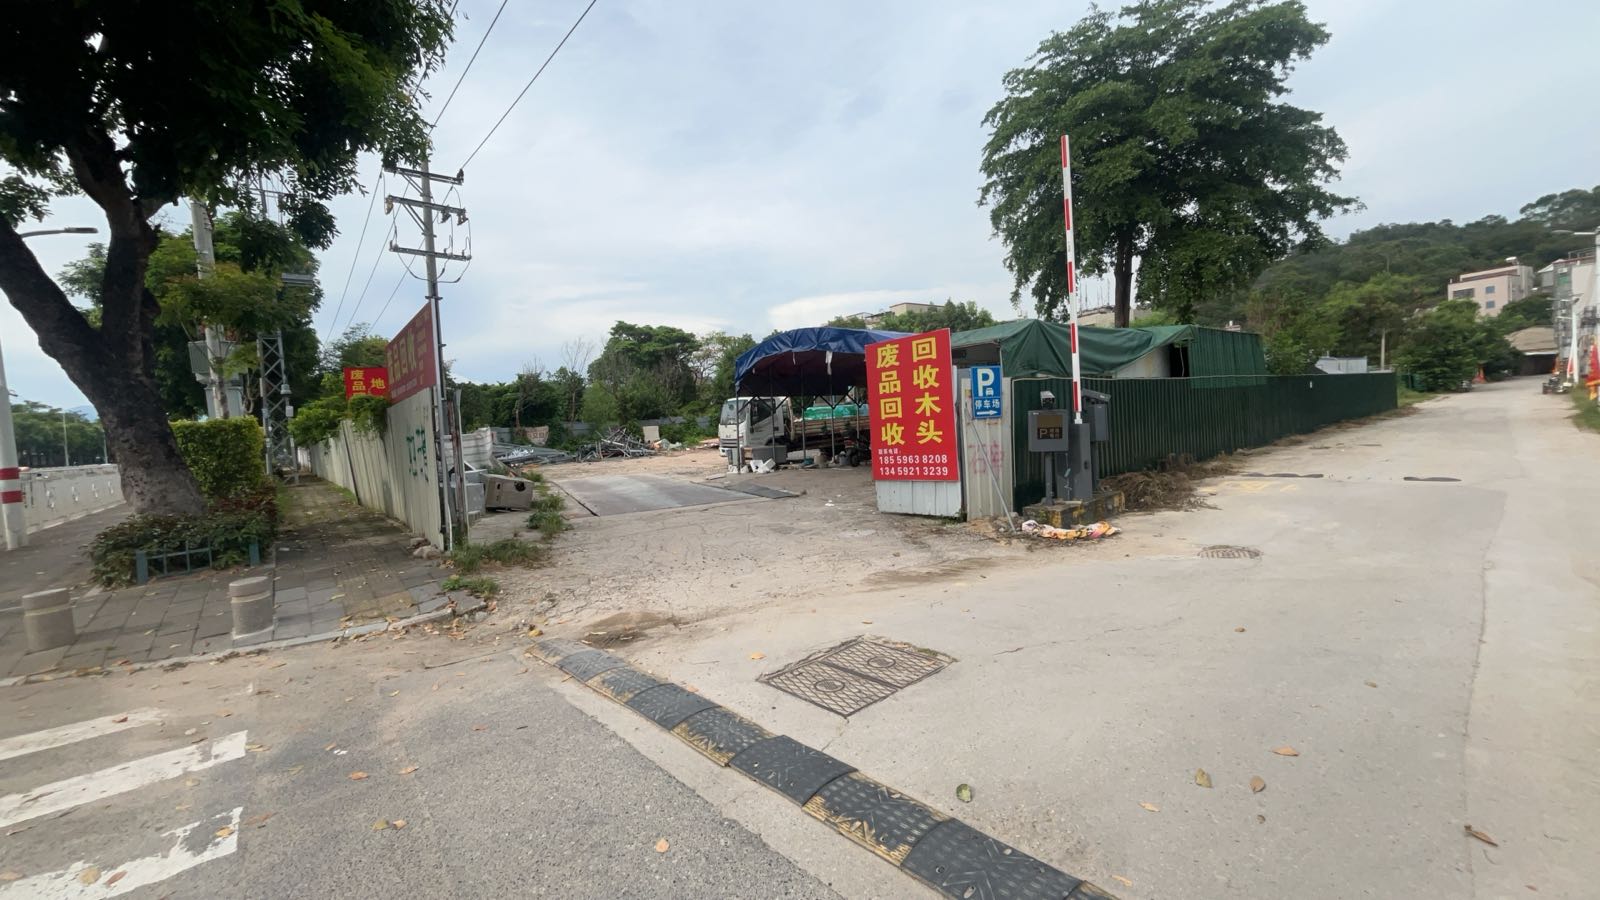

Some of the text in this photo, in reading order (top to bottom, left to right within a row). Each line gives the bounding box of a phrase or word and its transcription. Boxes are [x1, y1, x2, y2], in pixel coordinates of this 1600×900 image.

[350, 369, 367, 396] 废品
[370, 377, 386, 389] 地
[912, 337, 943, 445] 回收木头
[976, 368, 995, 397] P
[877, 343, 906, 446] 废品回收
[975, 399, 1000, 409] 停车场
[879, 454, 948, 464] 185 5963 8208
[880, 466, 948, 476] 134 5921 3239
